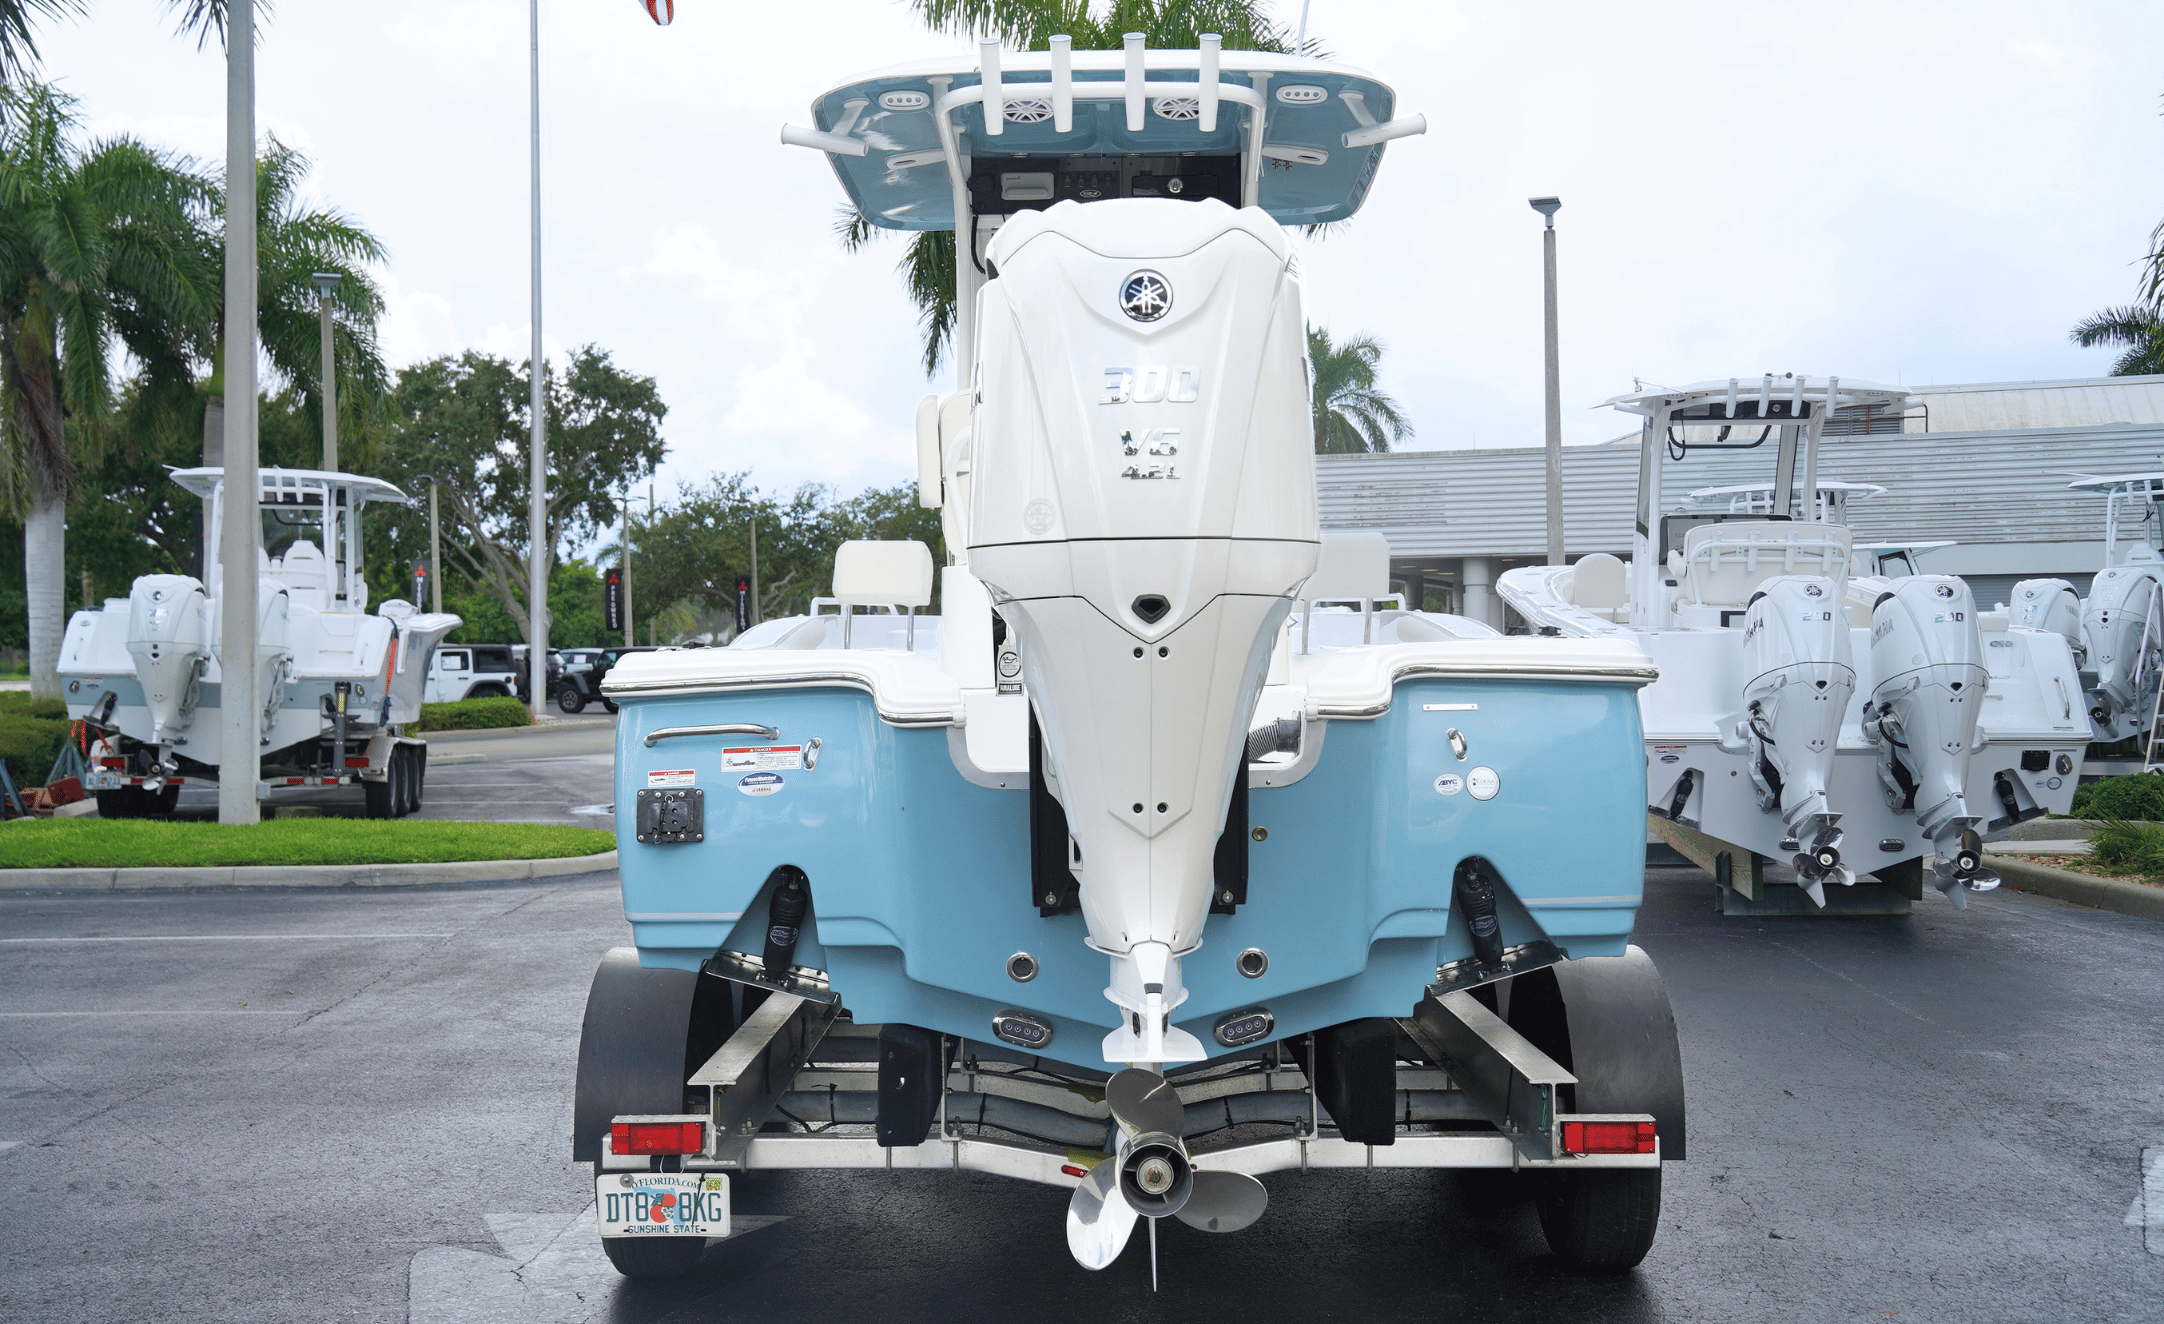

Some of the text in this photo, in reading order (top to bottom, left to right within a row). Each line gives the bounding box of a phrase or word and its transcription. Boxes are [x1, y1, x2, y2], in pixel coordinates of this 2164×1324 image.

[1098, 365, 1200, 405] 300
[1119, 428, 1181, 457] V6
[1121, 462, 1181, 481] 4.2L
[605, 1192, 722, 1223] DT8 8KG
[628, 1225, 700, 1234] SUNSHINE STATE
